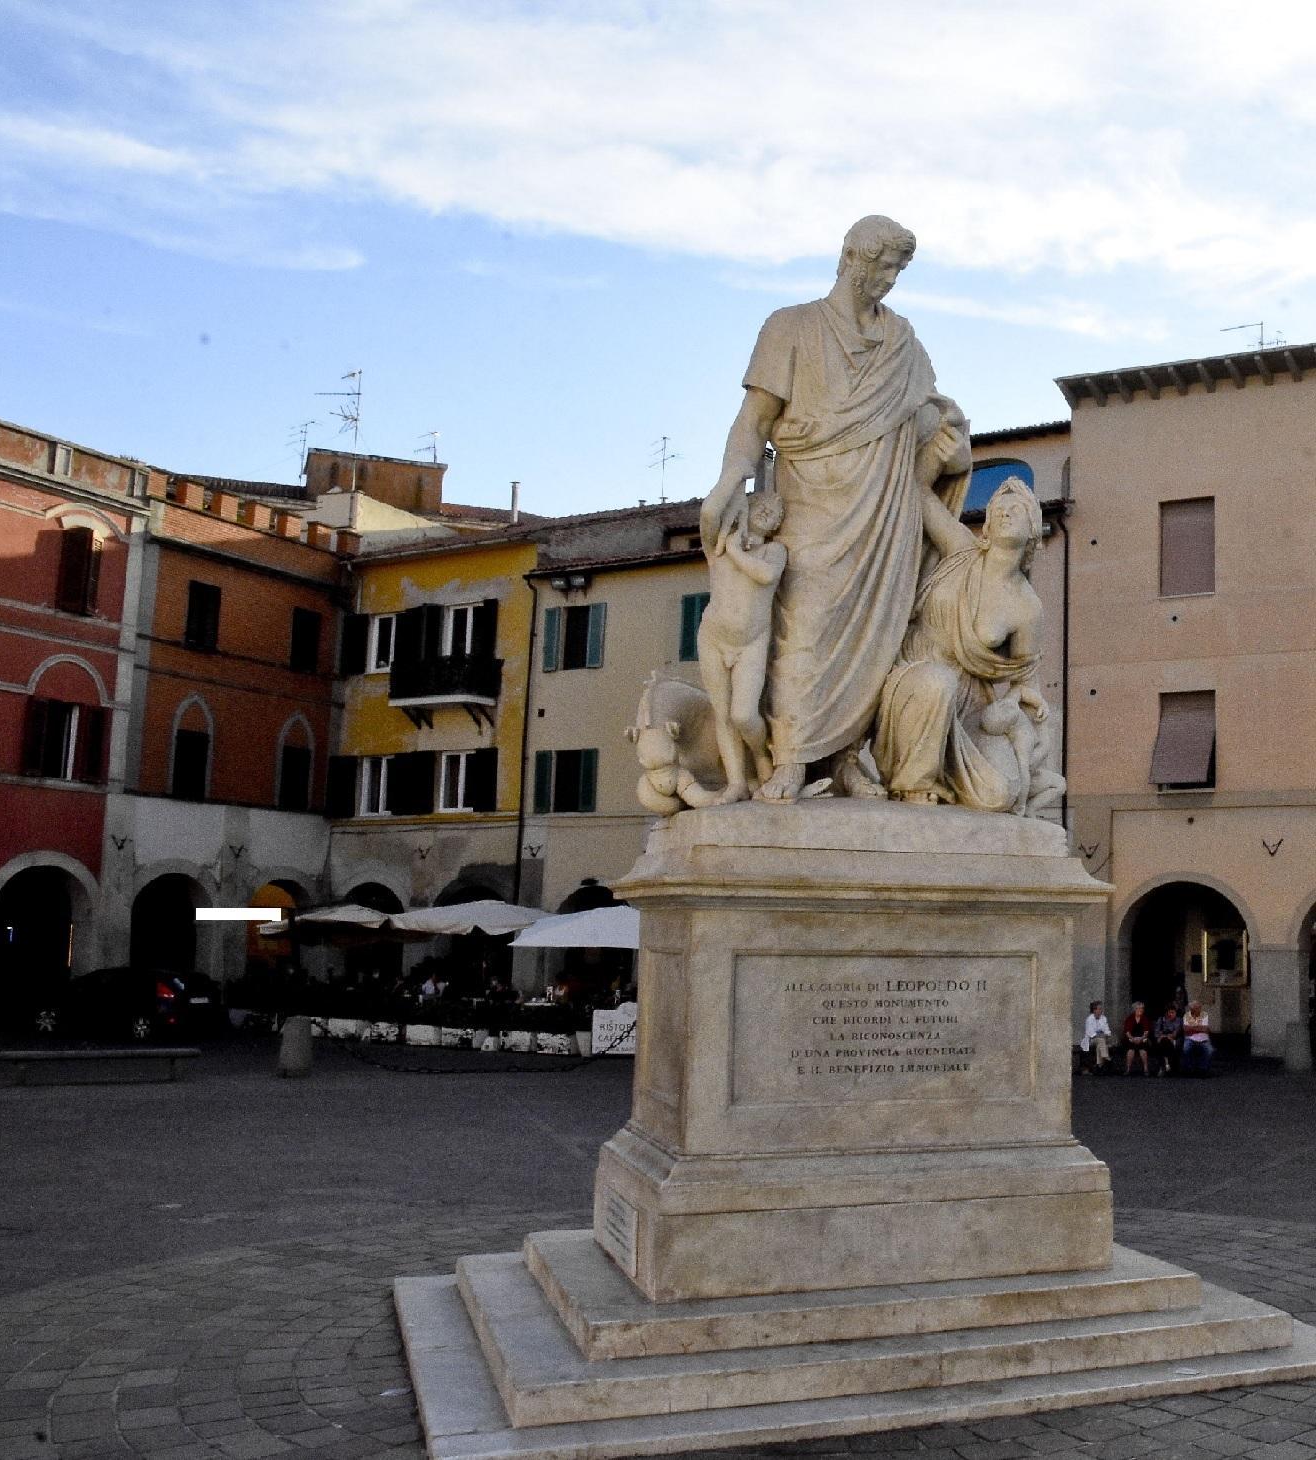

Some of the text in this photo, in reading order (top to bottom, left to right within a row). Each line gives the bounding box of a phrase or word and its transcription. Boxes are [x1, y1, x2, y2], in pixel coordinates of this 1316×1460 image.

[886, 980, 970, 992] LEOPOLDO
[822, 1000, 949, 1010] QUESTO MONUMENTO
[812, 1016, 837, 1025] CHE
[843, 1016, 892, 1025] RICORDI
[915, 1015, 958, 1024] FUTURI
[829, 1032, 941, 1041] LA RICONOSCENZA
[835, 1048, 900, 1057] PROVINCIA
[906, 1047, 976, 1056] RIGENERATA
[797, 1066, 805, 1074] E
[829, 1065, 894, 1074] BENEFIZIO
